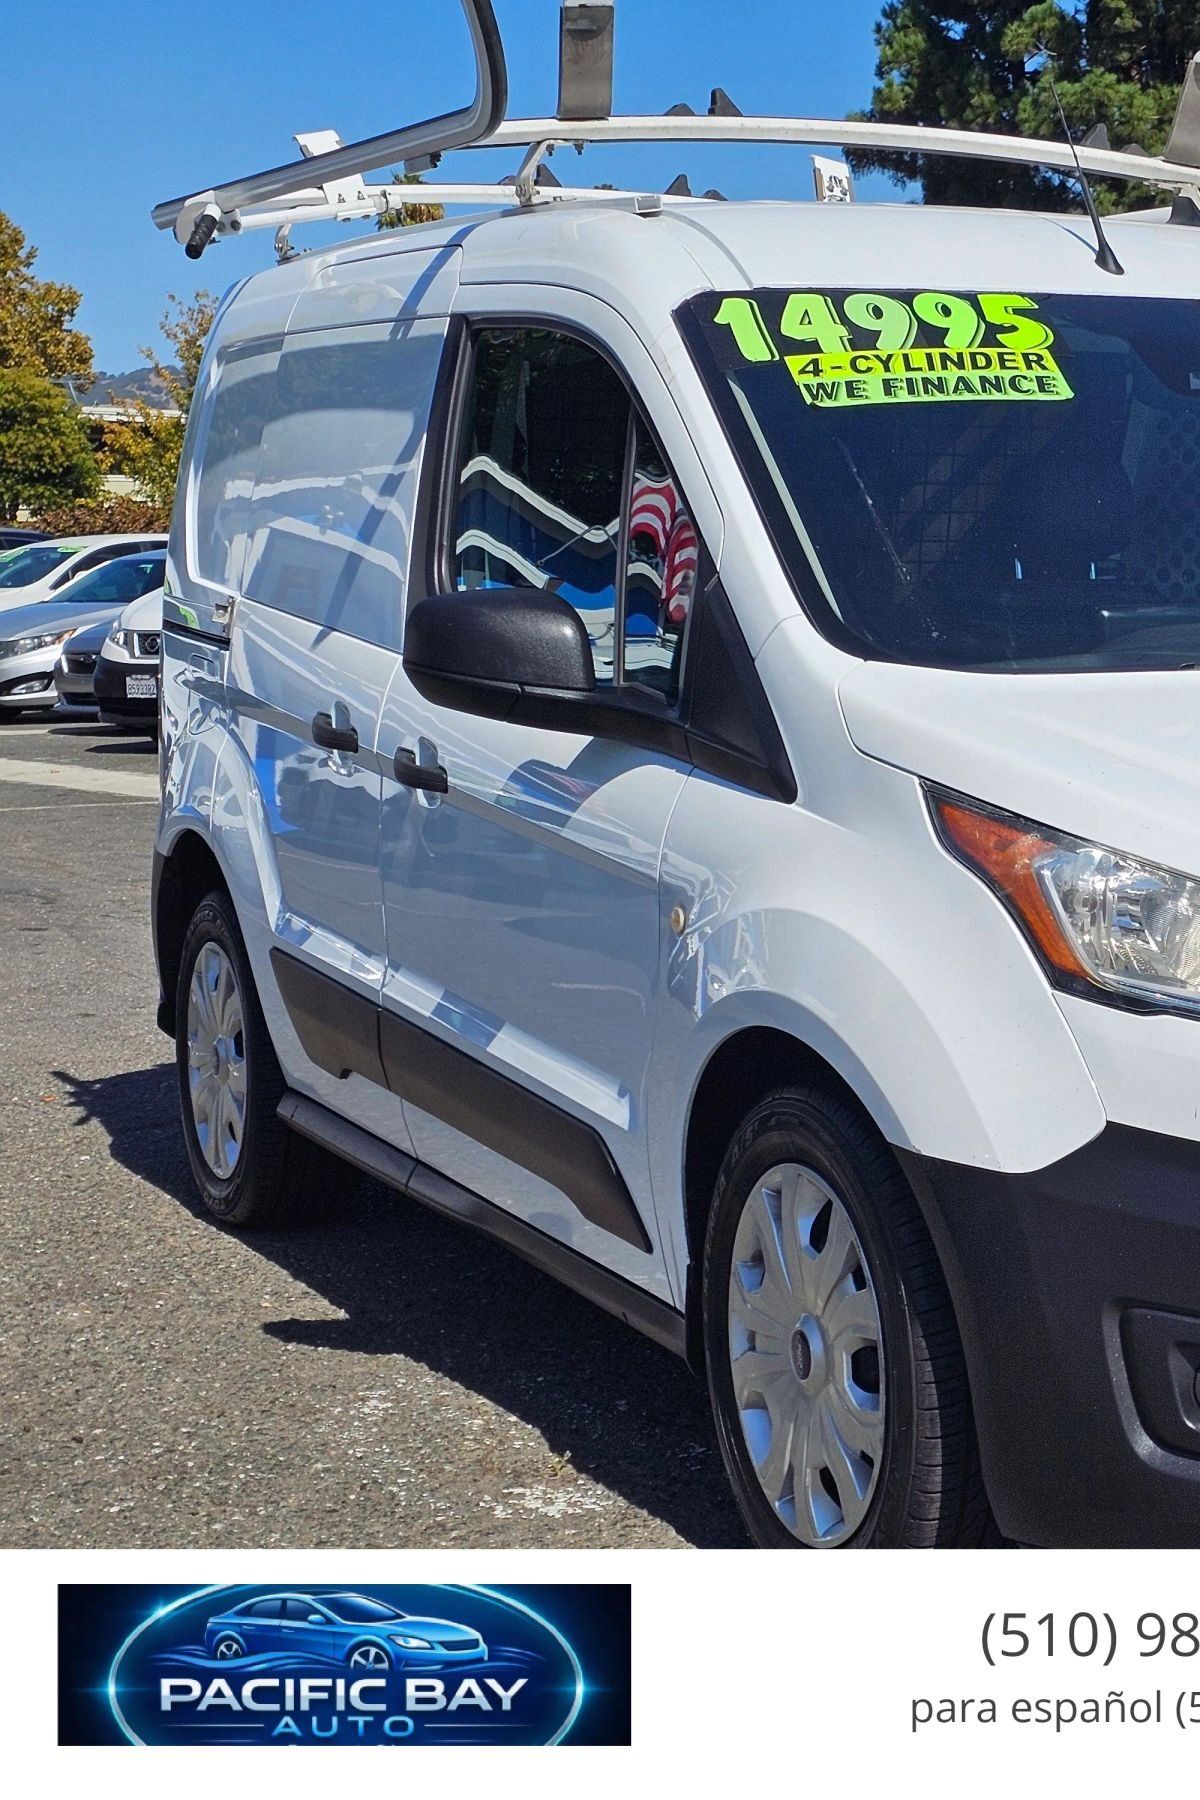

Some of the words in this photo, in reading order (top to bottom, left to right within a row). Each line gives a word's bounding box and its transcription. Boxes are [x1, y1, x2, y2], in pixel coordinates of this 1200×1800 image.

[713, 292, 1055, 362] 14995
[797, 351, 1051, 378] 4-CYLINDER
[803, 379, 868, 402] WE
[881, 374, 1059, 399] FINANCE
